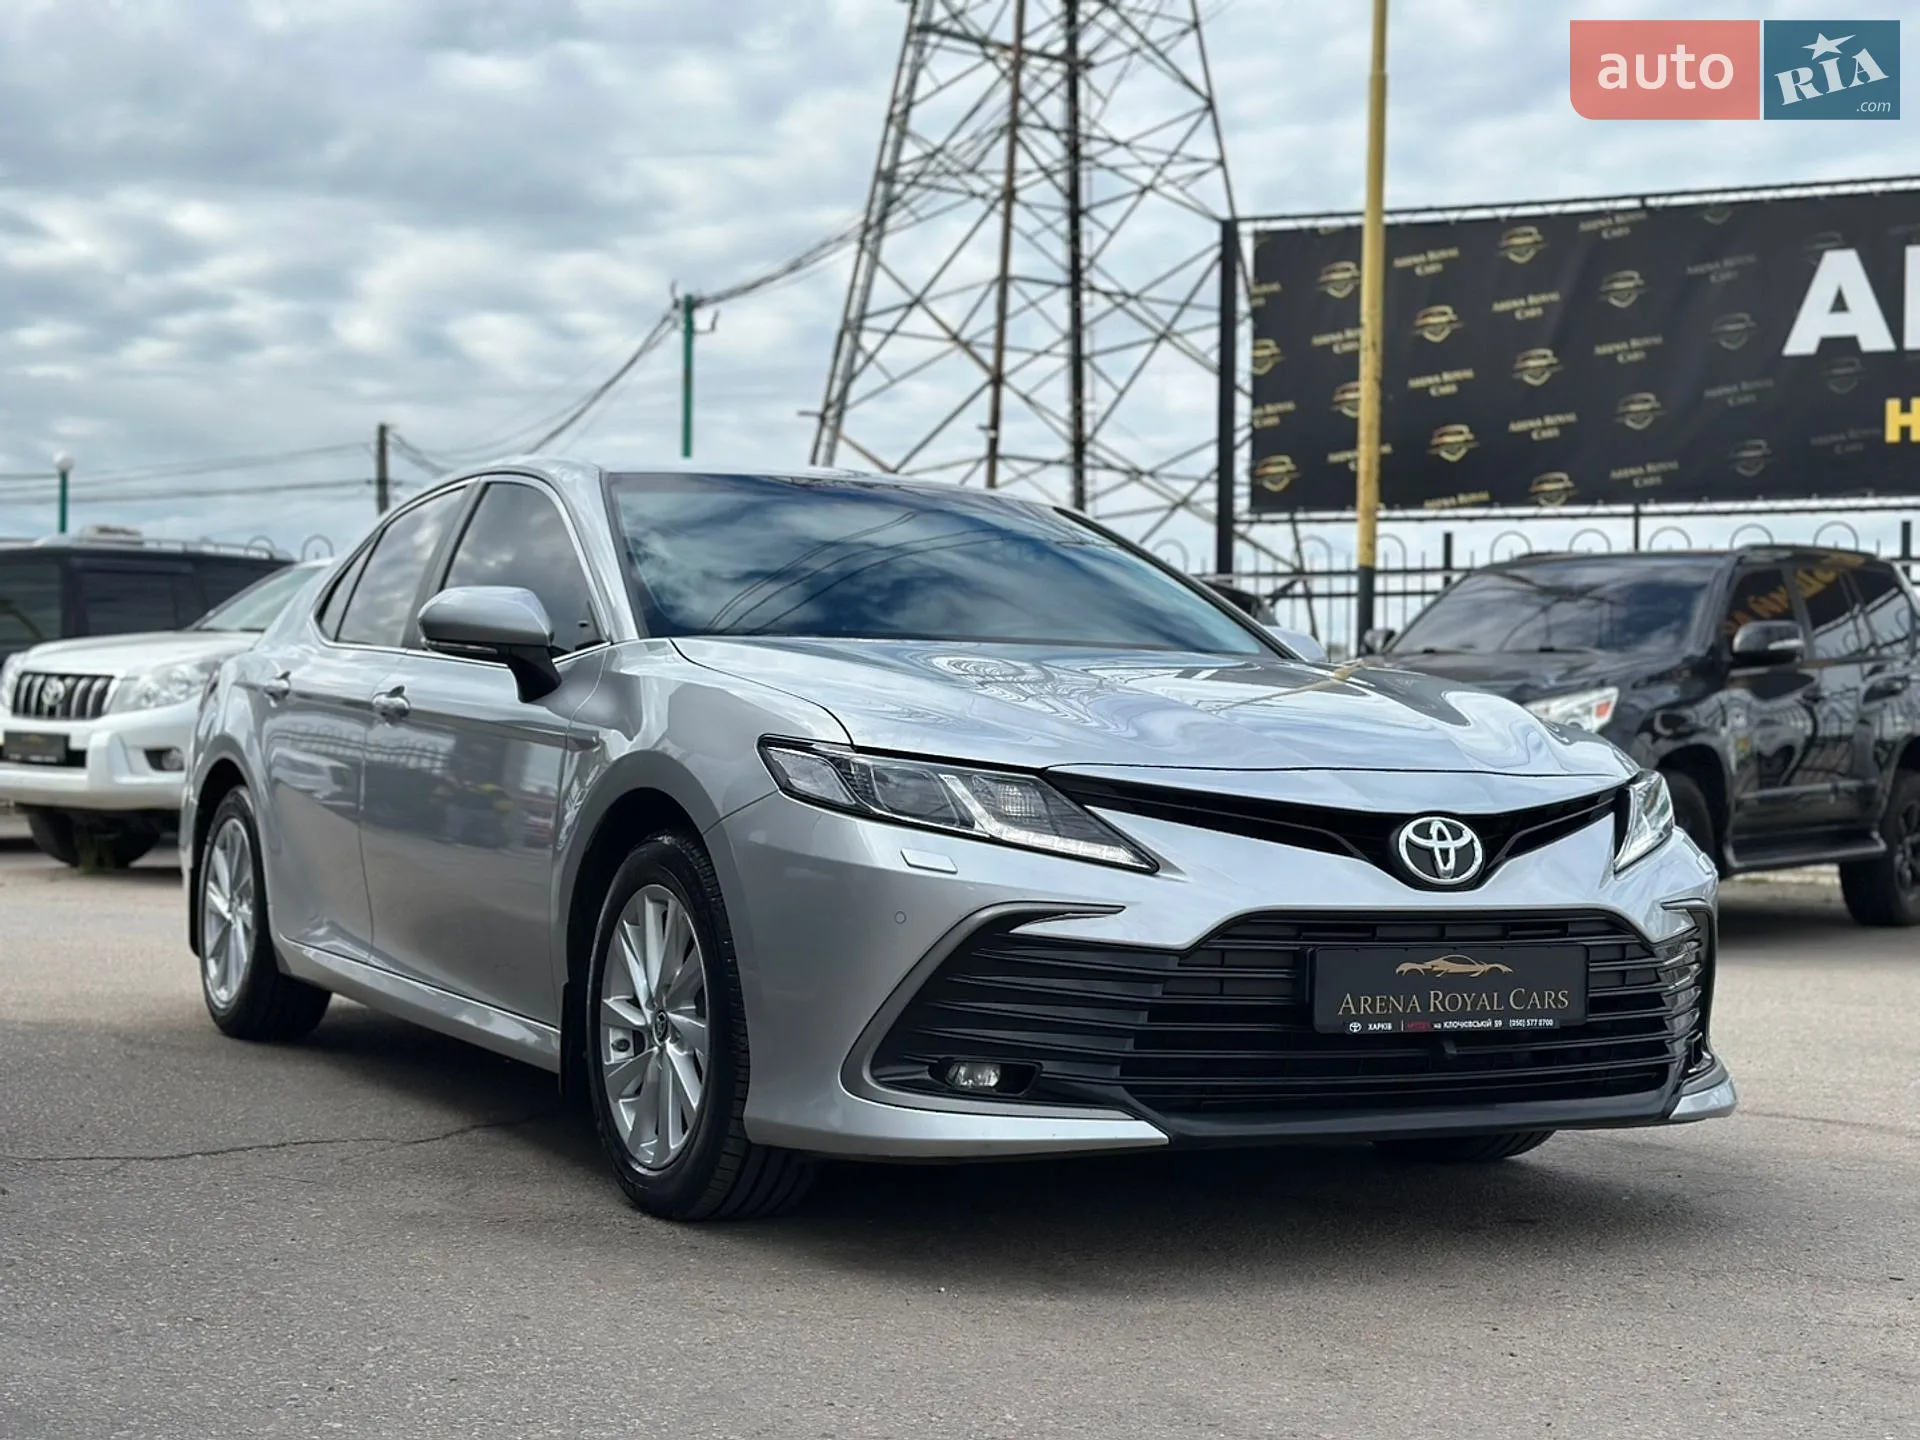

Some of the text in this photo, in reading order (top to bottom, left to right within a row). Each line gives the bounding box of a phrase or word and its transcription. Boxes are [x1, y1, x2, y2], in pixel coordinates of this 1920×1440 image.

[1782, 246, 1920, 355] A
[1338, 988, 1569, 1016] ARENA ROYAL CARS
